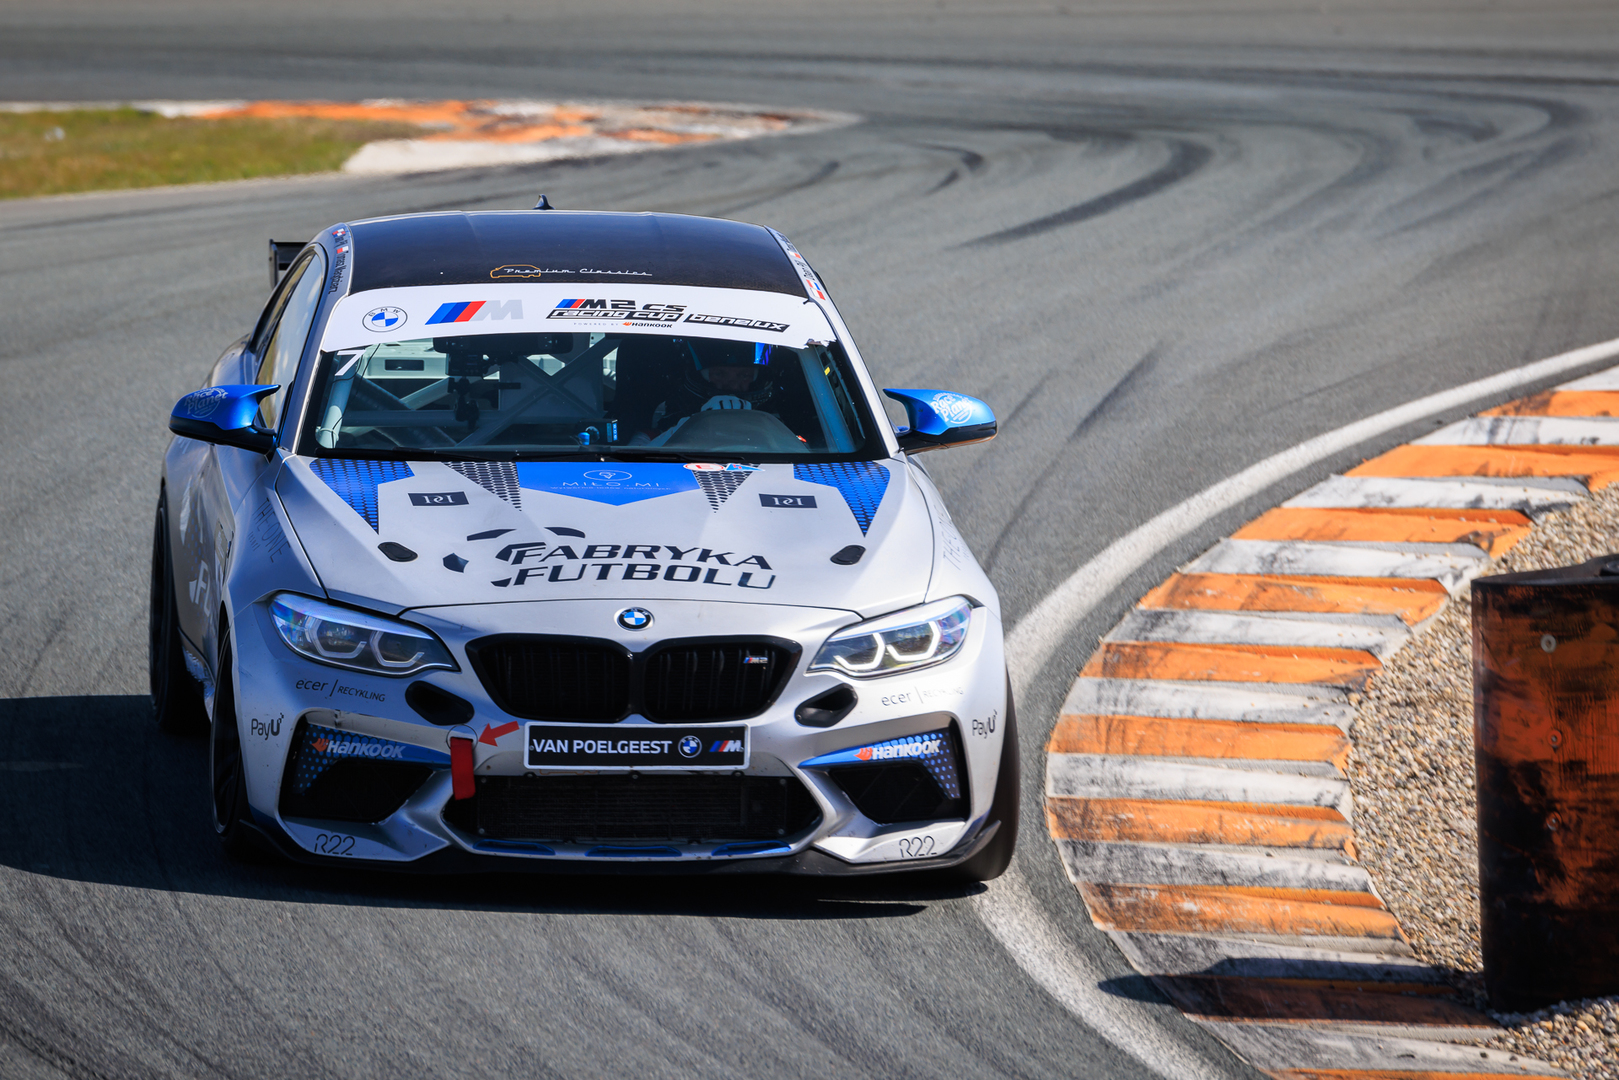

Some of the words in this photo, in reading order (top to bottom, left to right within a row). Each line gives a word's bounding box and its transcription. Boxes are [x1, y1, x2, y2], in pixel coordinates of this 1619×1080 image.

[579, 268, 653, 276] Classics
[550, 309, 631, 319] racing
[632, 311, 680, 321] cup
[642, 303, 688, 312] CS
[688, 314, 786, 330] benelux
[334, 349, 367, 376] 7
[930, 395, 956, 414] Race
[940, 397, 973, 422] Planet
[511, 544, 774, 570] FABRYKA
[513, 563, 777, 590] FUTBOLU
[295, 679, 328, 692] ecer
[337, 685, 386, 702] RECYKLING
[881, 692, 911, 706] ecer
[251, 714, 284, 741] PayU
[972, 711, 997, 739] PayU
[326, 740, 406, 759] Hankook
[532, 739, 569, 753] VAN
[573, 740, 673, 754] POELGEEST
[872, 739, 941, 760] Hankook
[314, 833, 356, 856] R22
[899, 835, 938, 858] R22
